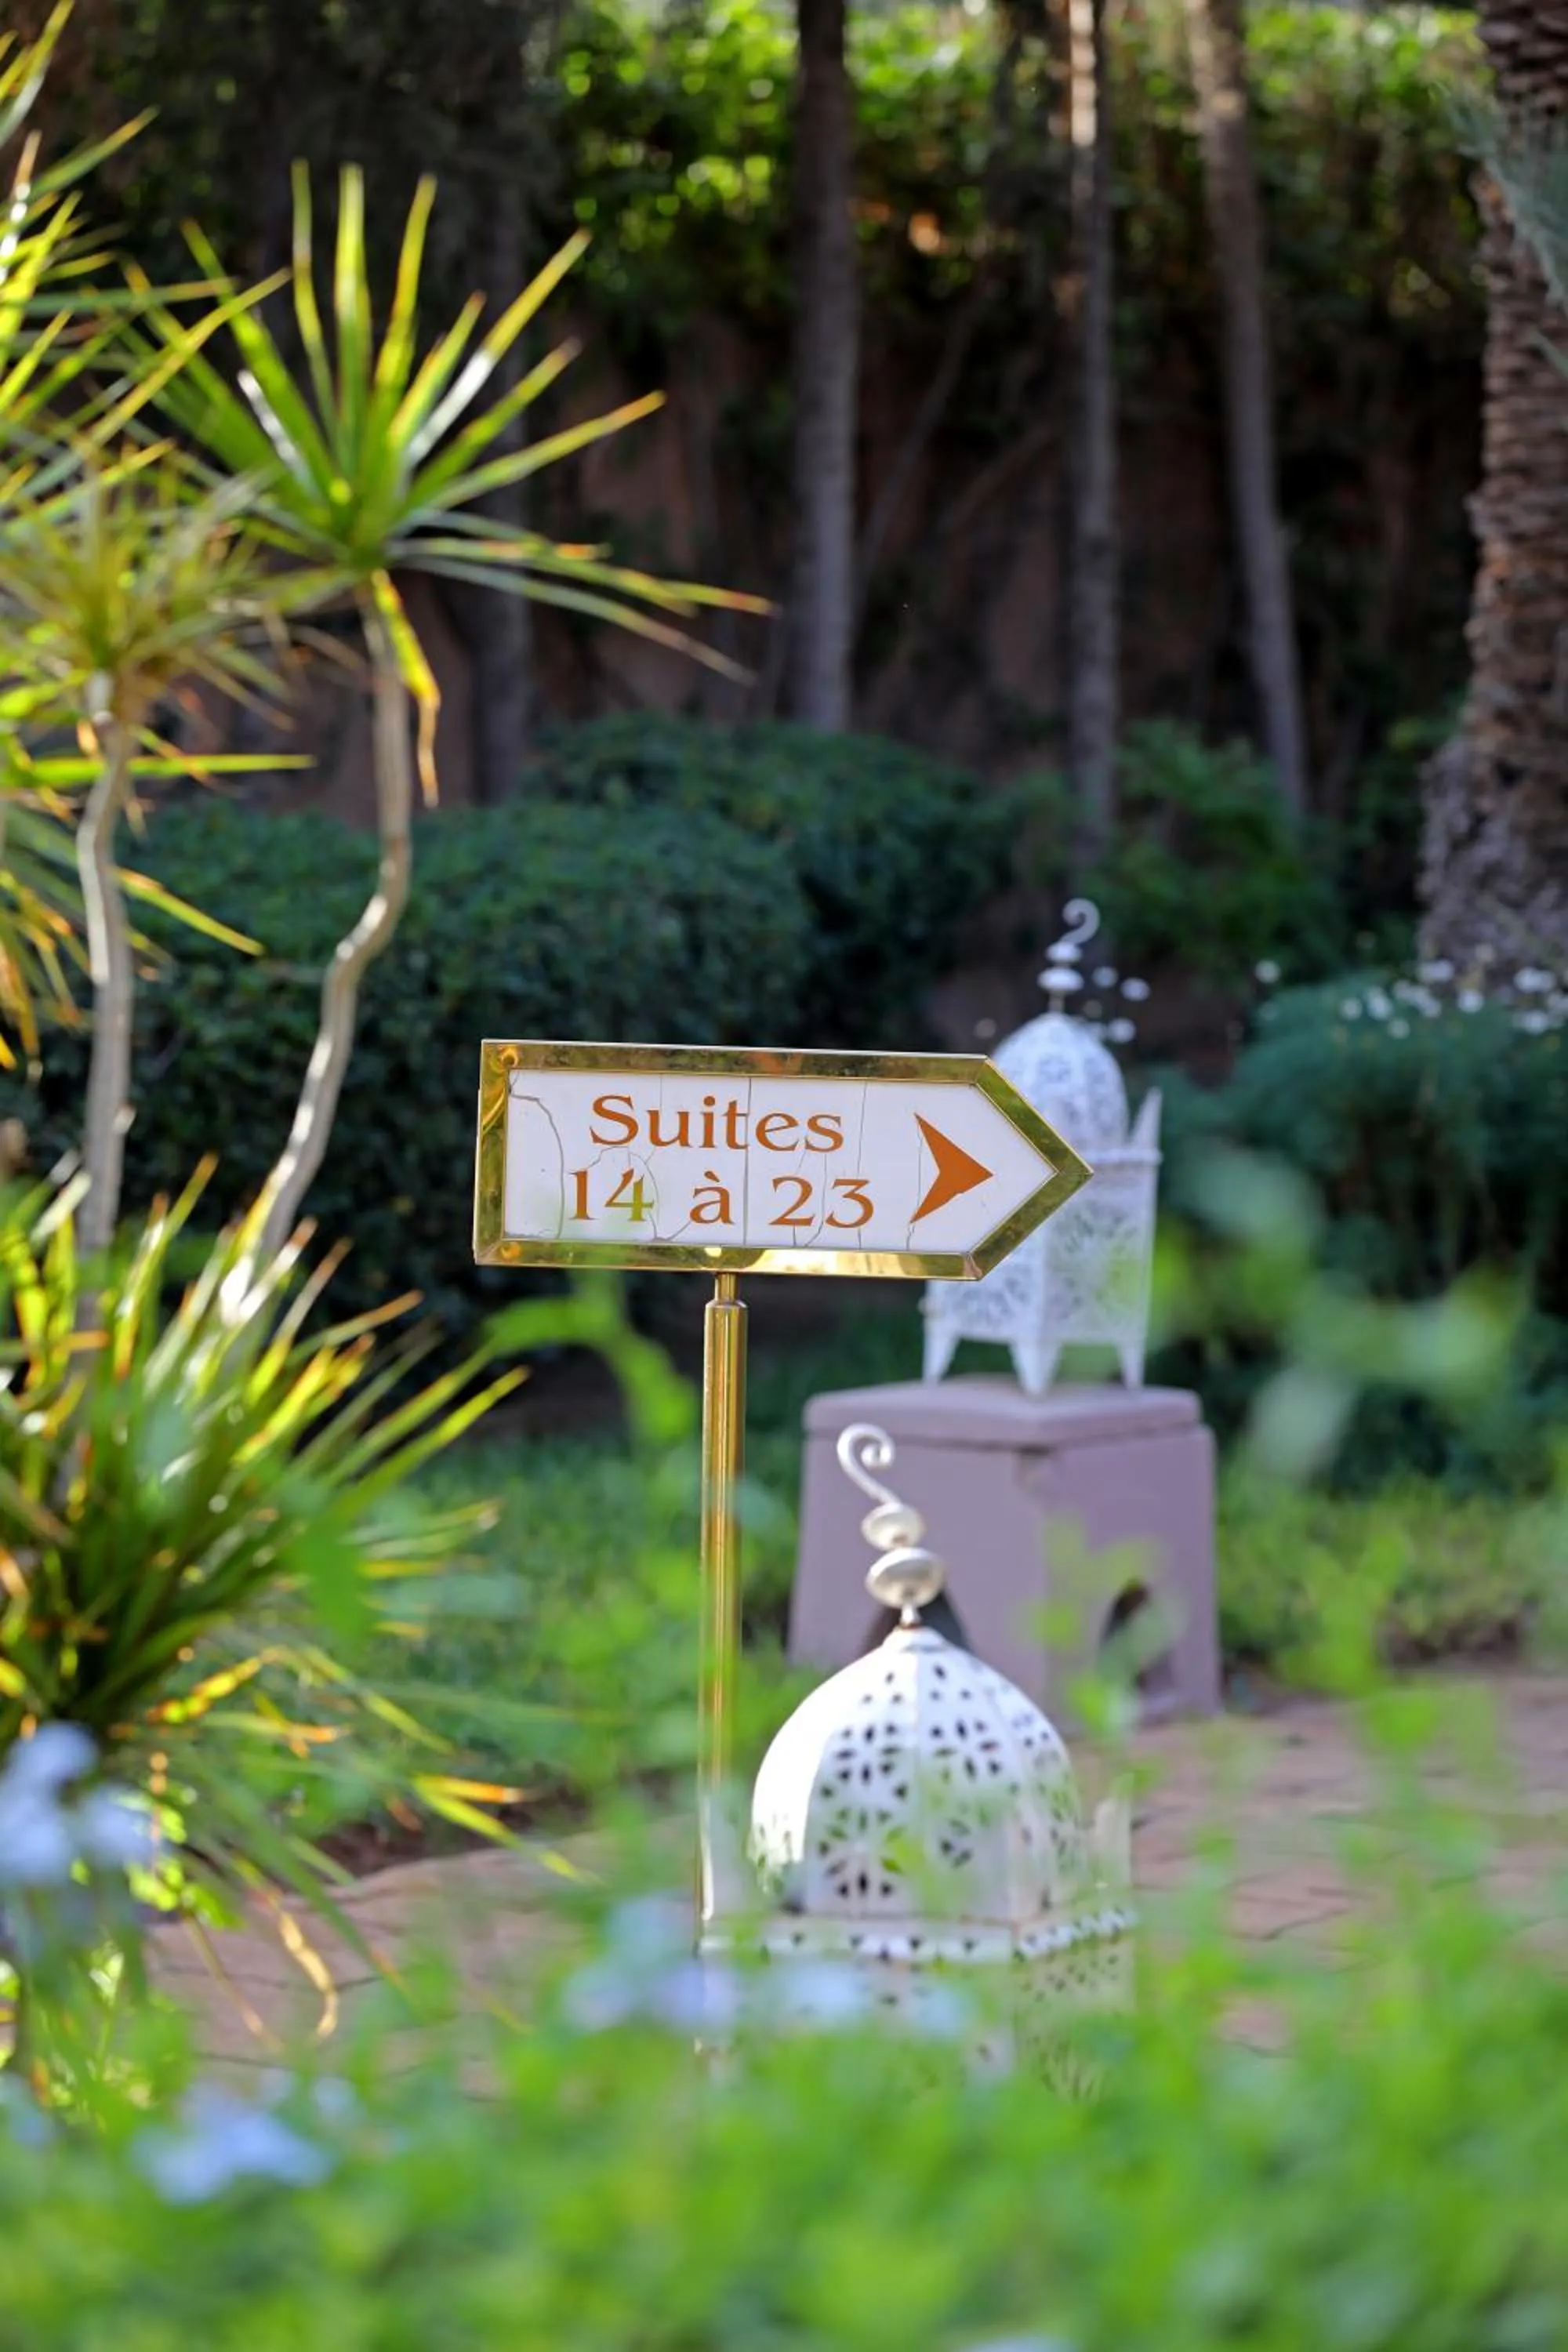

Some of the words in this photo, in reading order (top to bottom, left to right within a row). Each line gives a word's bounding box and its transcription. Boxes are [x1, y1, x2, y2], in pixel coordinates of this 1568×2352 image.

[589, 1094, 844, 1152] Suites
[568, 1168, 654, 1223] 14
[688, 1171, 735, 1226] à
[768, 1176, 876, 1229] 23
